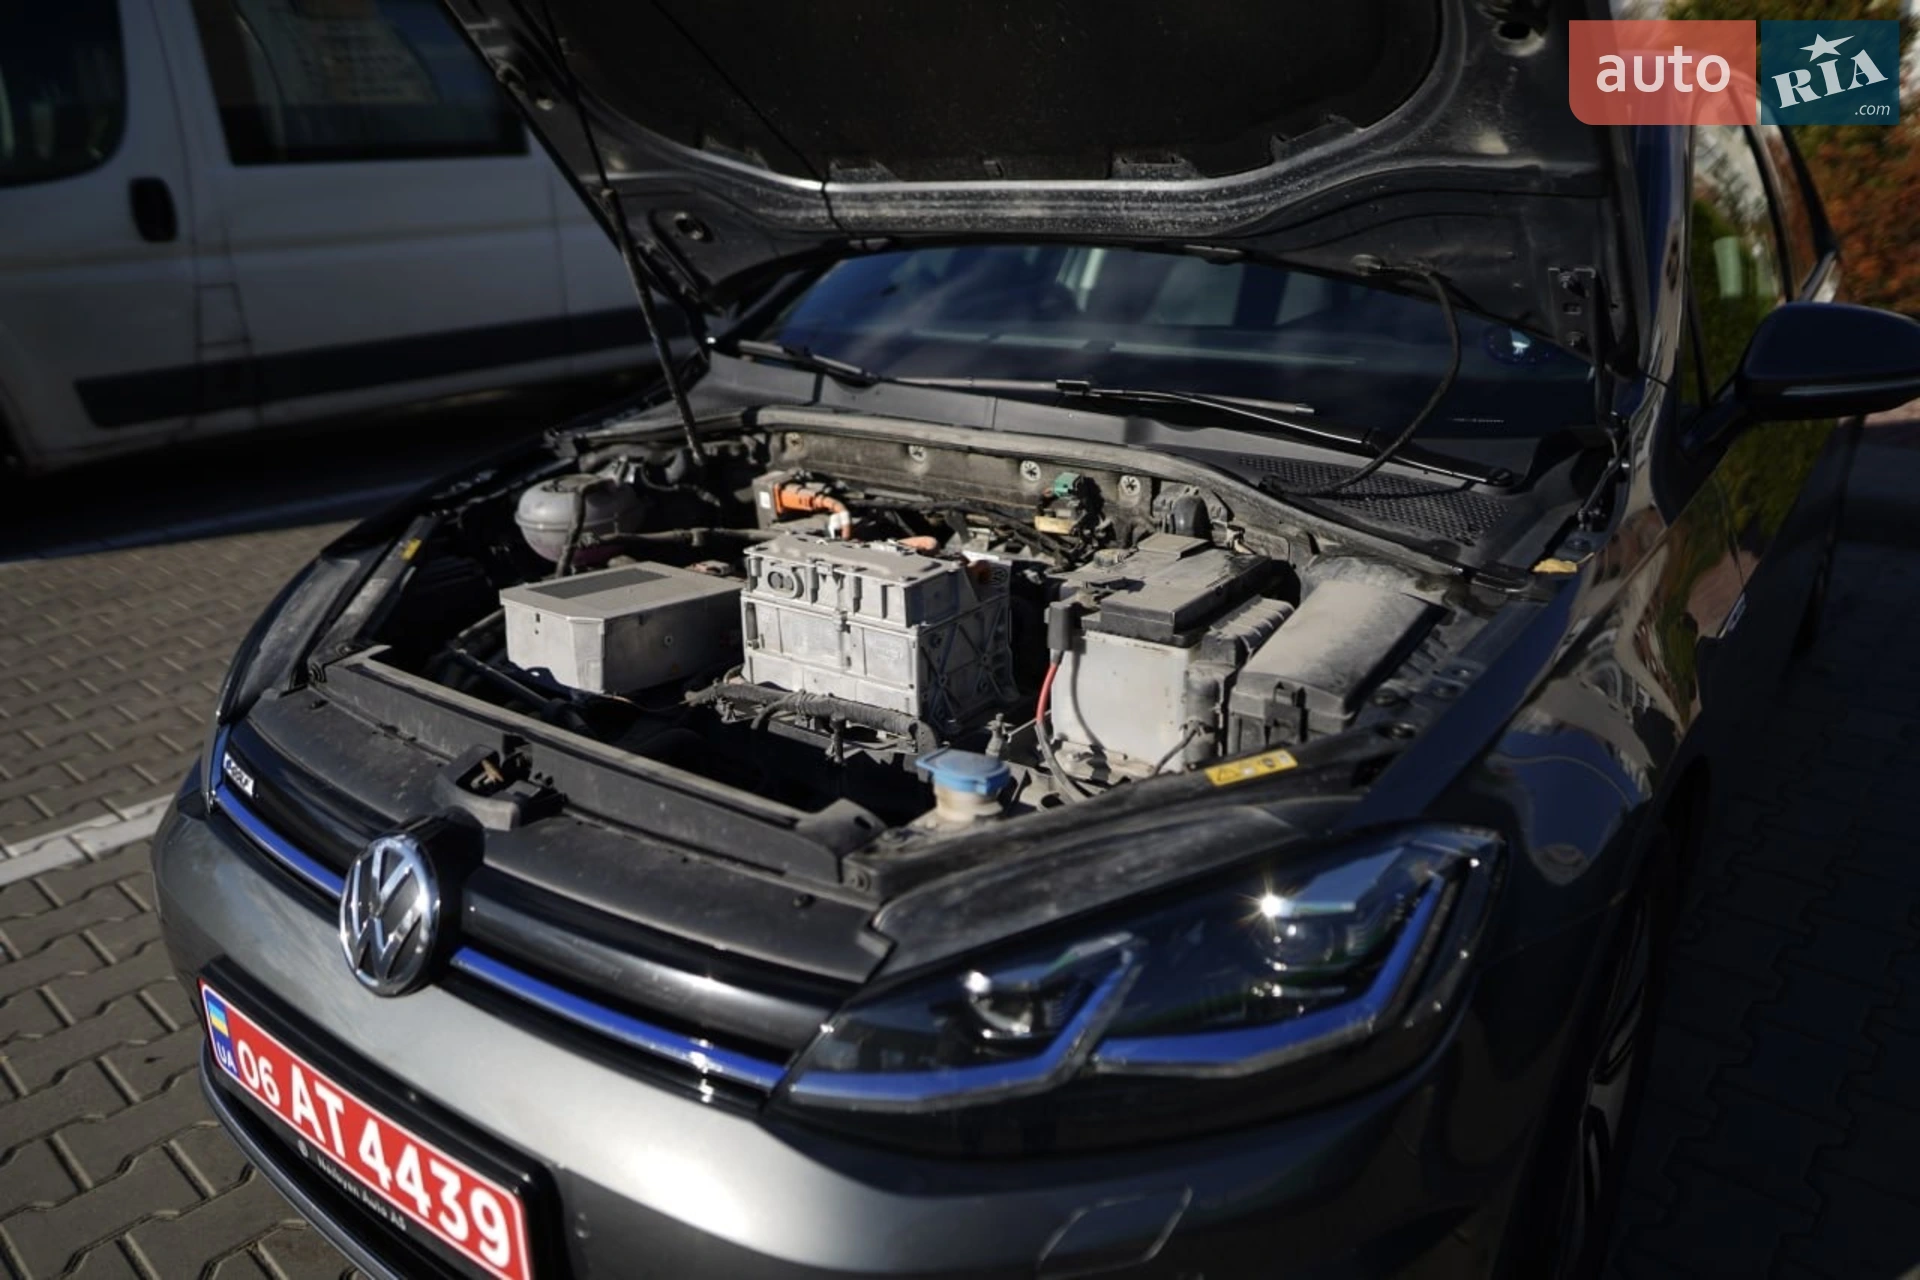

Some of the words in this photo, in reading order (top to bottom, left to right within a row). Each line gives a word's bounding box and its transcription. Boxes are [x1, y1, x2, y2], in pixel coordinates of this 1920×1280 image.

[216, 1041, 238, 1074] UA
[237, 1039, 281, 1107] 06
[291, 1063, 346, 1159] AT
[358, 1118, 511, 1268] 4439
